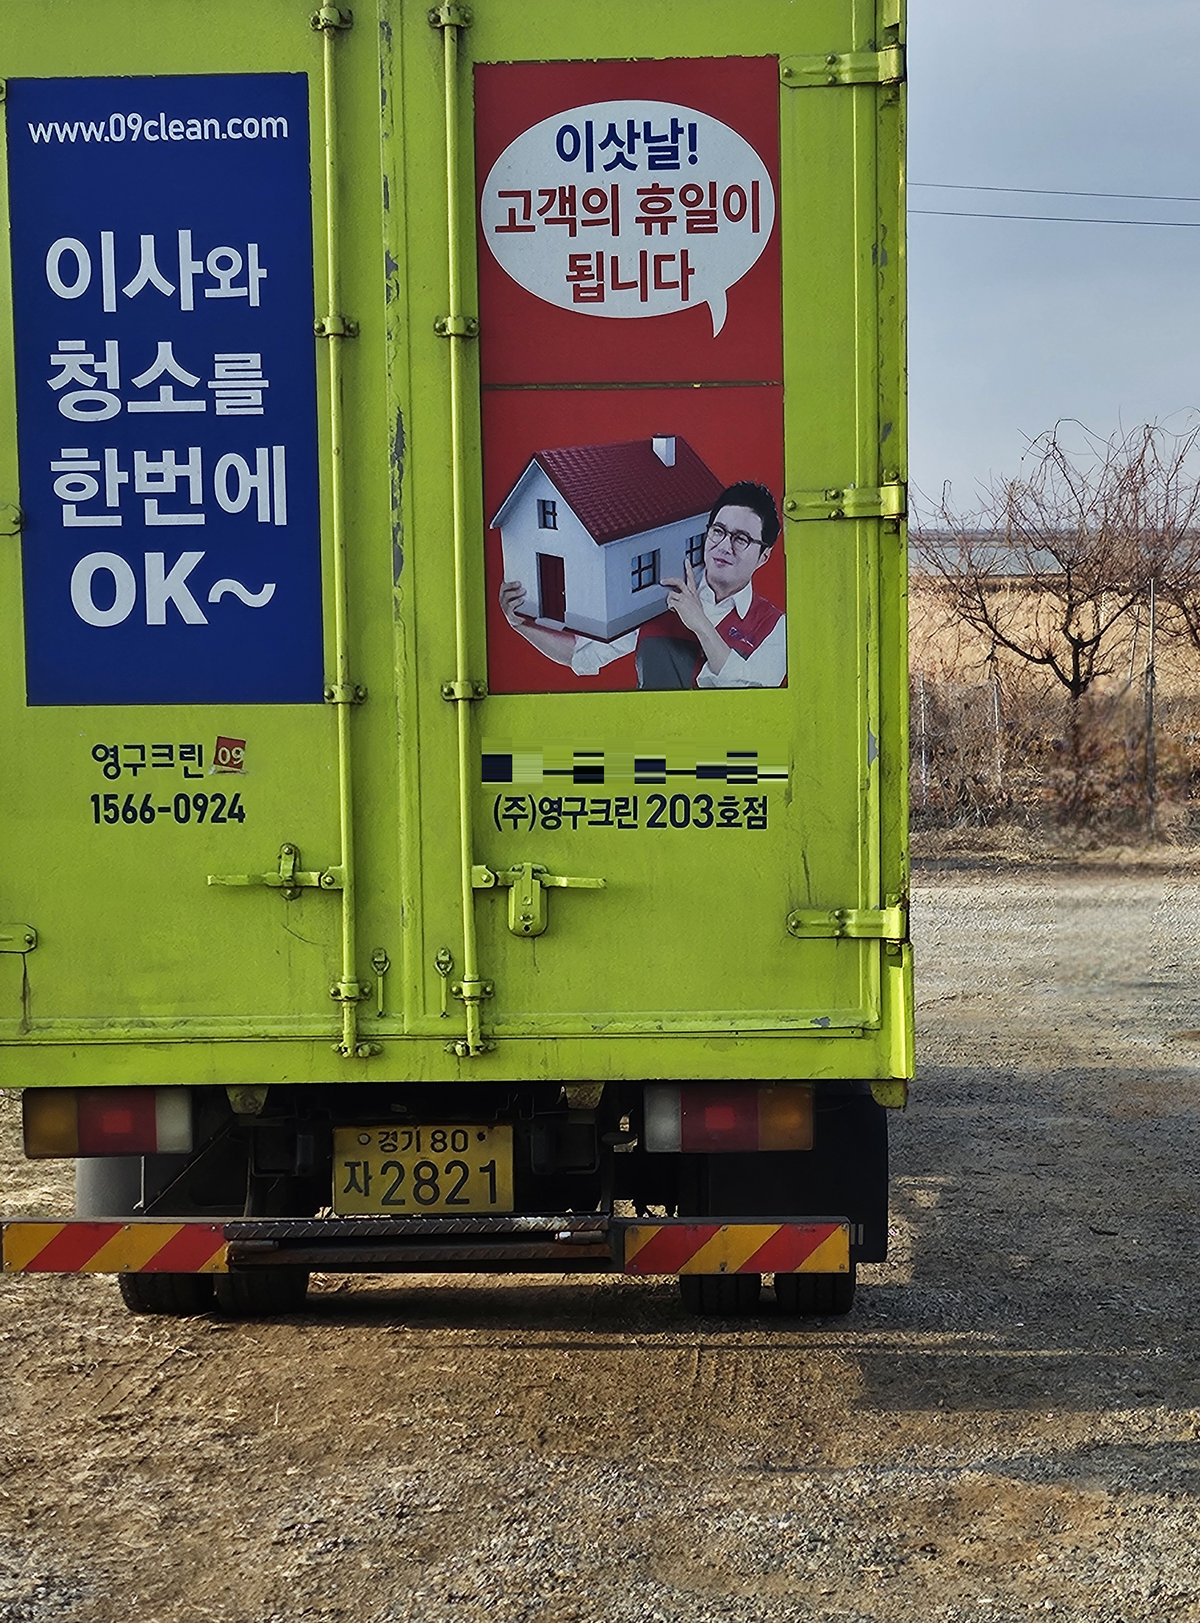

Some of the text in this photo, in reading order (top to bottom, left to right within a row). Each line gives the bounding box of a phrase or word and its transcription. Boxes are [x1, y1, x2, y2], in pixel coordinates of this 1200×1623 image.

[28, 112, 289, 144] www.09clean.com
[555, 117, 699, 173] 이삿날!
[494, 180, 761, 238] 고객의 휴일이
[45, 229, 268, 313] 이사와
[565, 248, 696, 304] 됩니다
[46, 339, 270, 423] 청소를
[50, 445, 288, 527] 한번에
[91, 743, 246, 780] 영구크린 09
[90, 792, 246, 825] 1566-0924
[493, 793, 639, 832] (주)영구크린
